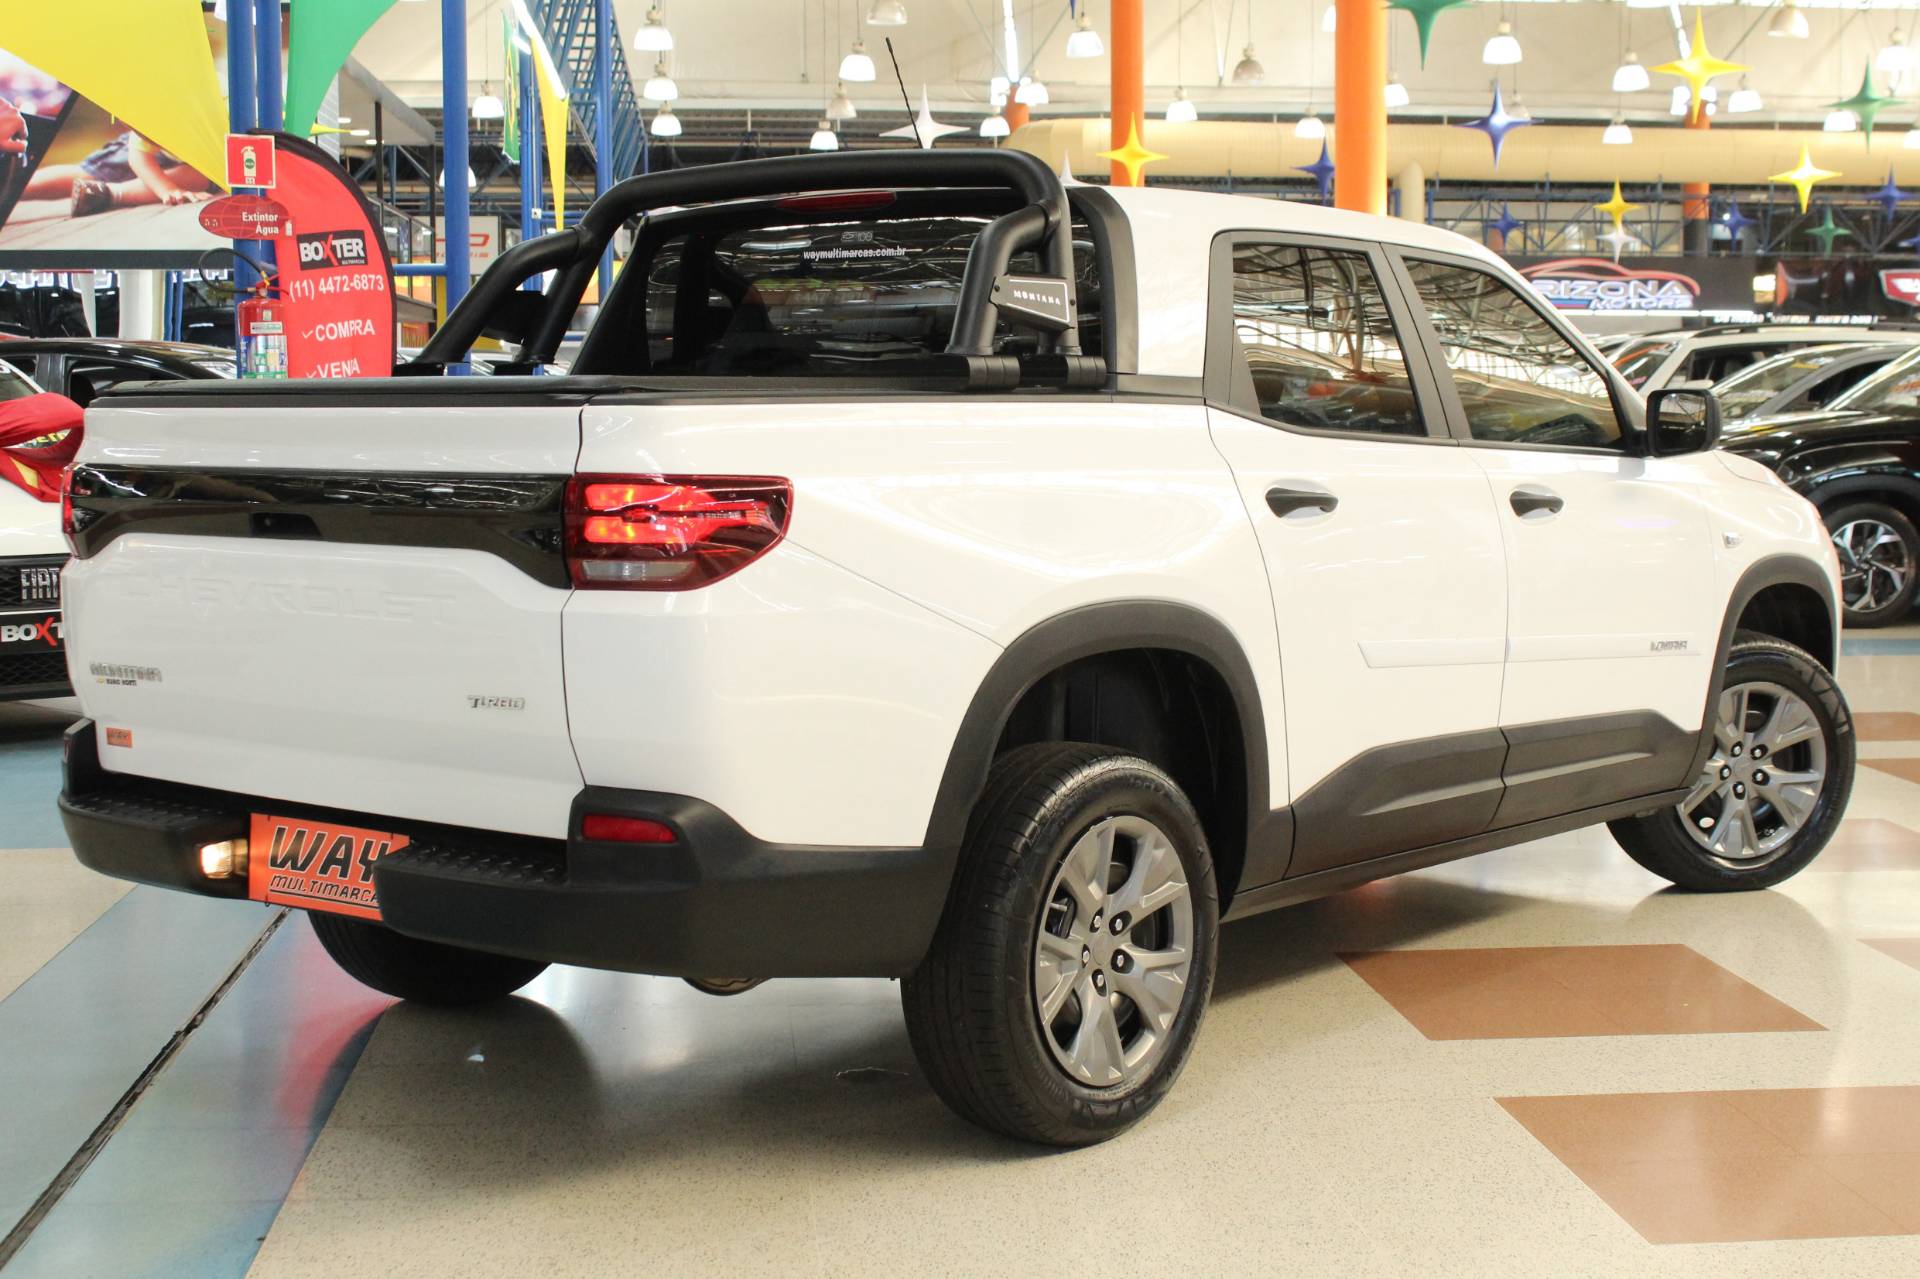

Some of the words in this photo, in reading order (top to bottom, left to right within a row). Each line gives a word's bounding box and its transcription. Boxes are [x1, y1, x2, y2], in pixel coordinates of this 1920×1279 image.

[242, 212, 279, 222] Extintor
[255, 223, 279, 235] Água
[300, 234, 365, 265] BOXTER
[803, 246, 906, 261] waymultimarcas.com.br
[289, 278, 315, 302] (11)
[318, 274, 385, 294] 4472-6873
[1014, 290, 1061, 305] MONTANA
[1588, 296, 1693, 310] MOTORS
[315, 319, 375, 341] COMPRA
[20, 567, 60, 600] FIAT
[268, 825, 392, 884] WAY
